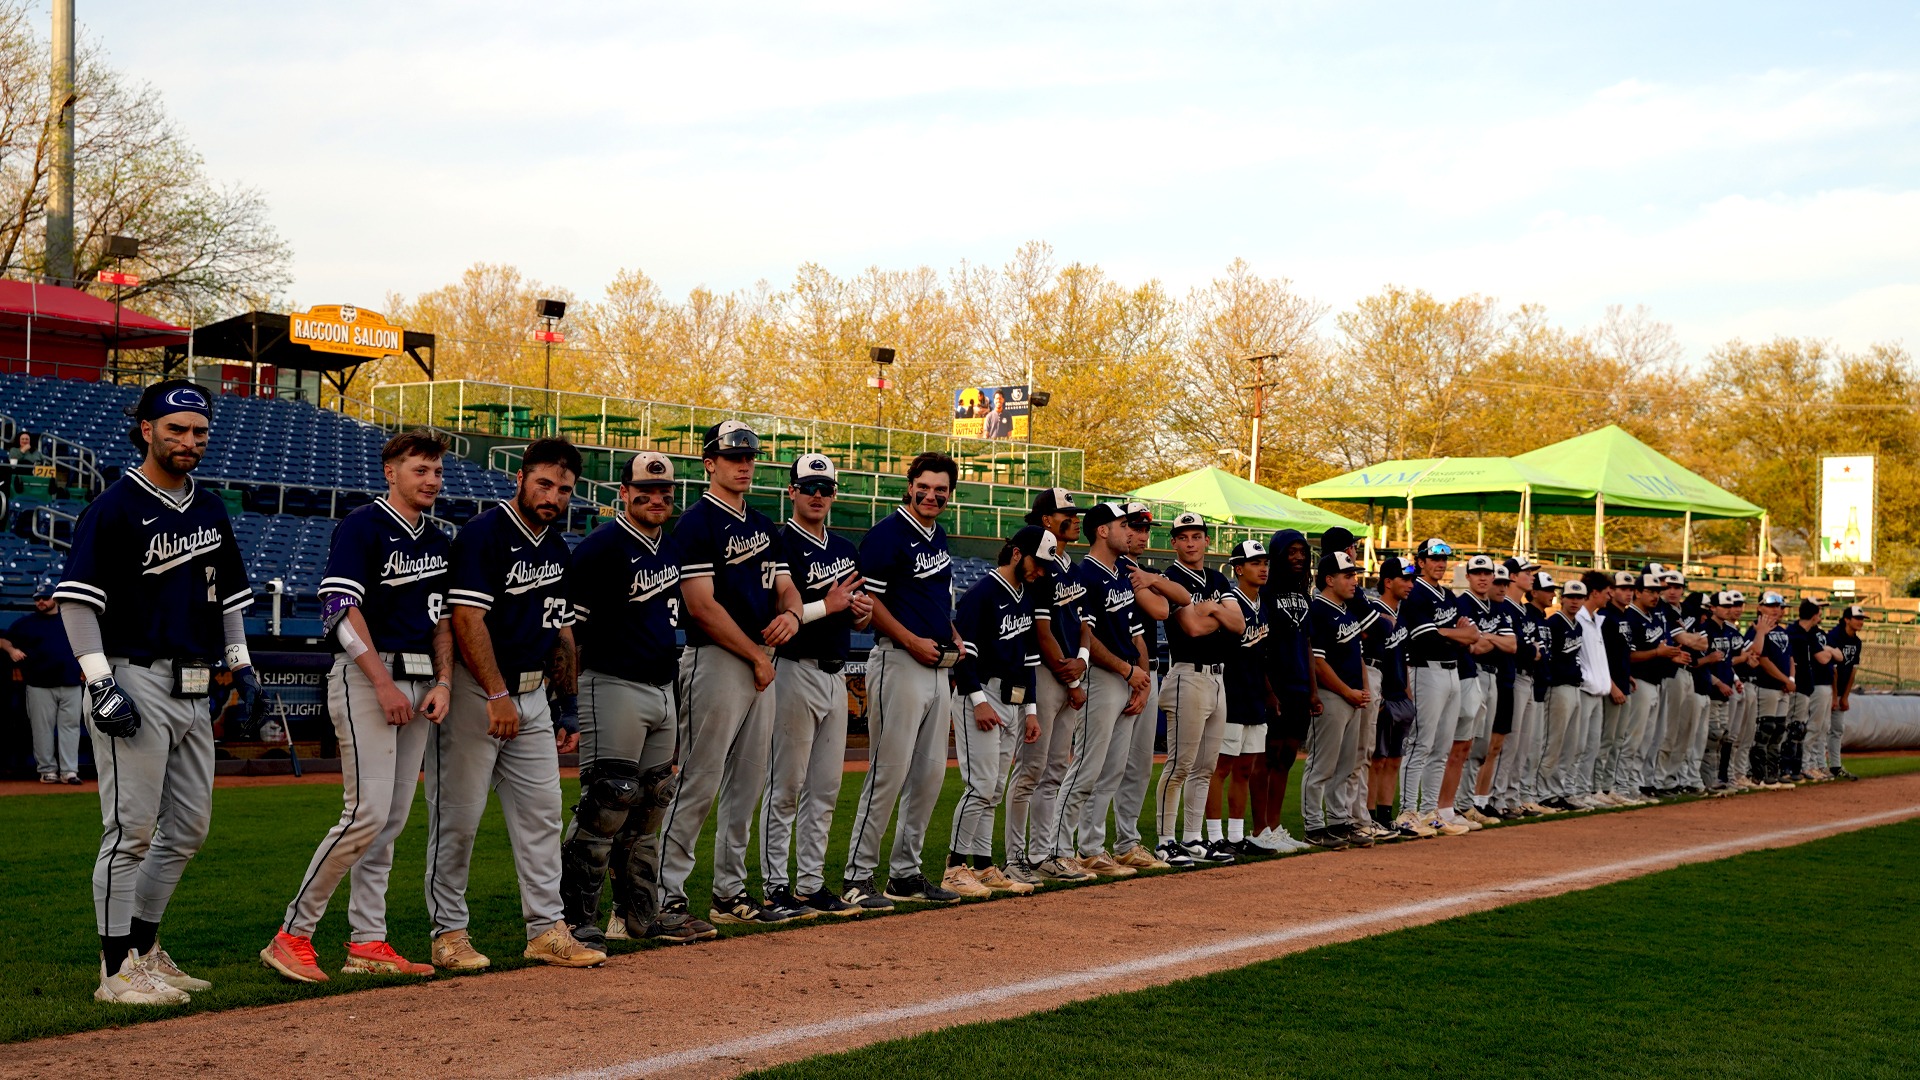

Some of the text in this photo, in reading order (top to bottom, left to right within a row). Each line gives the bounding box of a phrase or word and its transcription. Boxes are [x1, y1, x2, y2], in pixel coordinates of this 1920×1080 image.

[295, 319, 399, 350] RACCOON SALOON
[142, 525, 222, 566] Abington
[381, 550, 448, 581] Abington
[505, 560, 565, 588] Abington
[629, 564, 680, 597] Abington
[806, 556, 855, 584] Abington
[340, 597, 354, 607] ALL
[542, 597, 567, 629] 23
